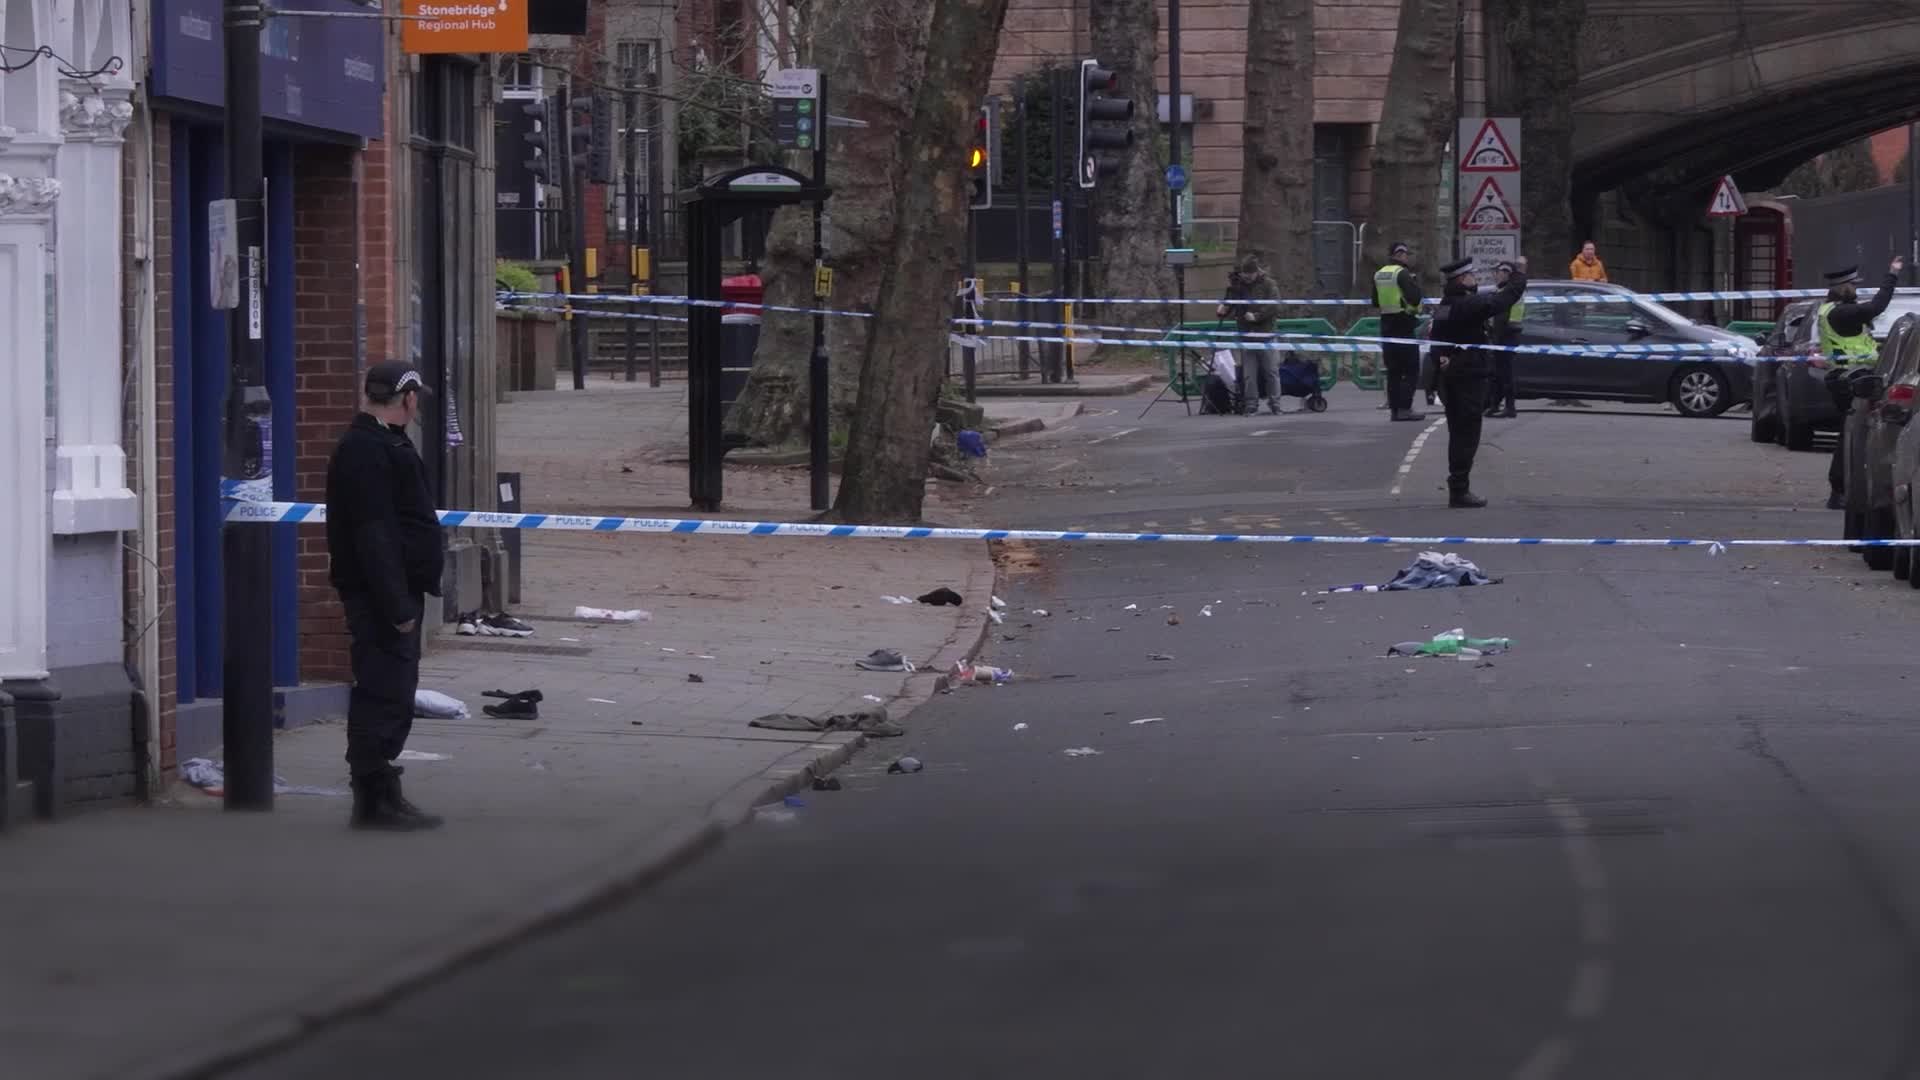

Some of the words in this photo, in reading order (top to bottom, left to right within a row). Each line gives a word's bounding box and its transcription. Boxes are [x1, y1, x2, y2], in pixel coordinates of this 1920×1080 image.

[418, 4, 496, 17] Stonebridge
[418, 20, 469, 32] Regional
[471, 20, 496, 30] Hub
[240, 506, 277, 518] POLICE
[476, 513, 513, 524] POLICE
